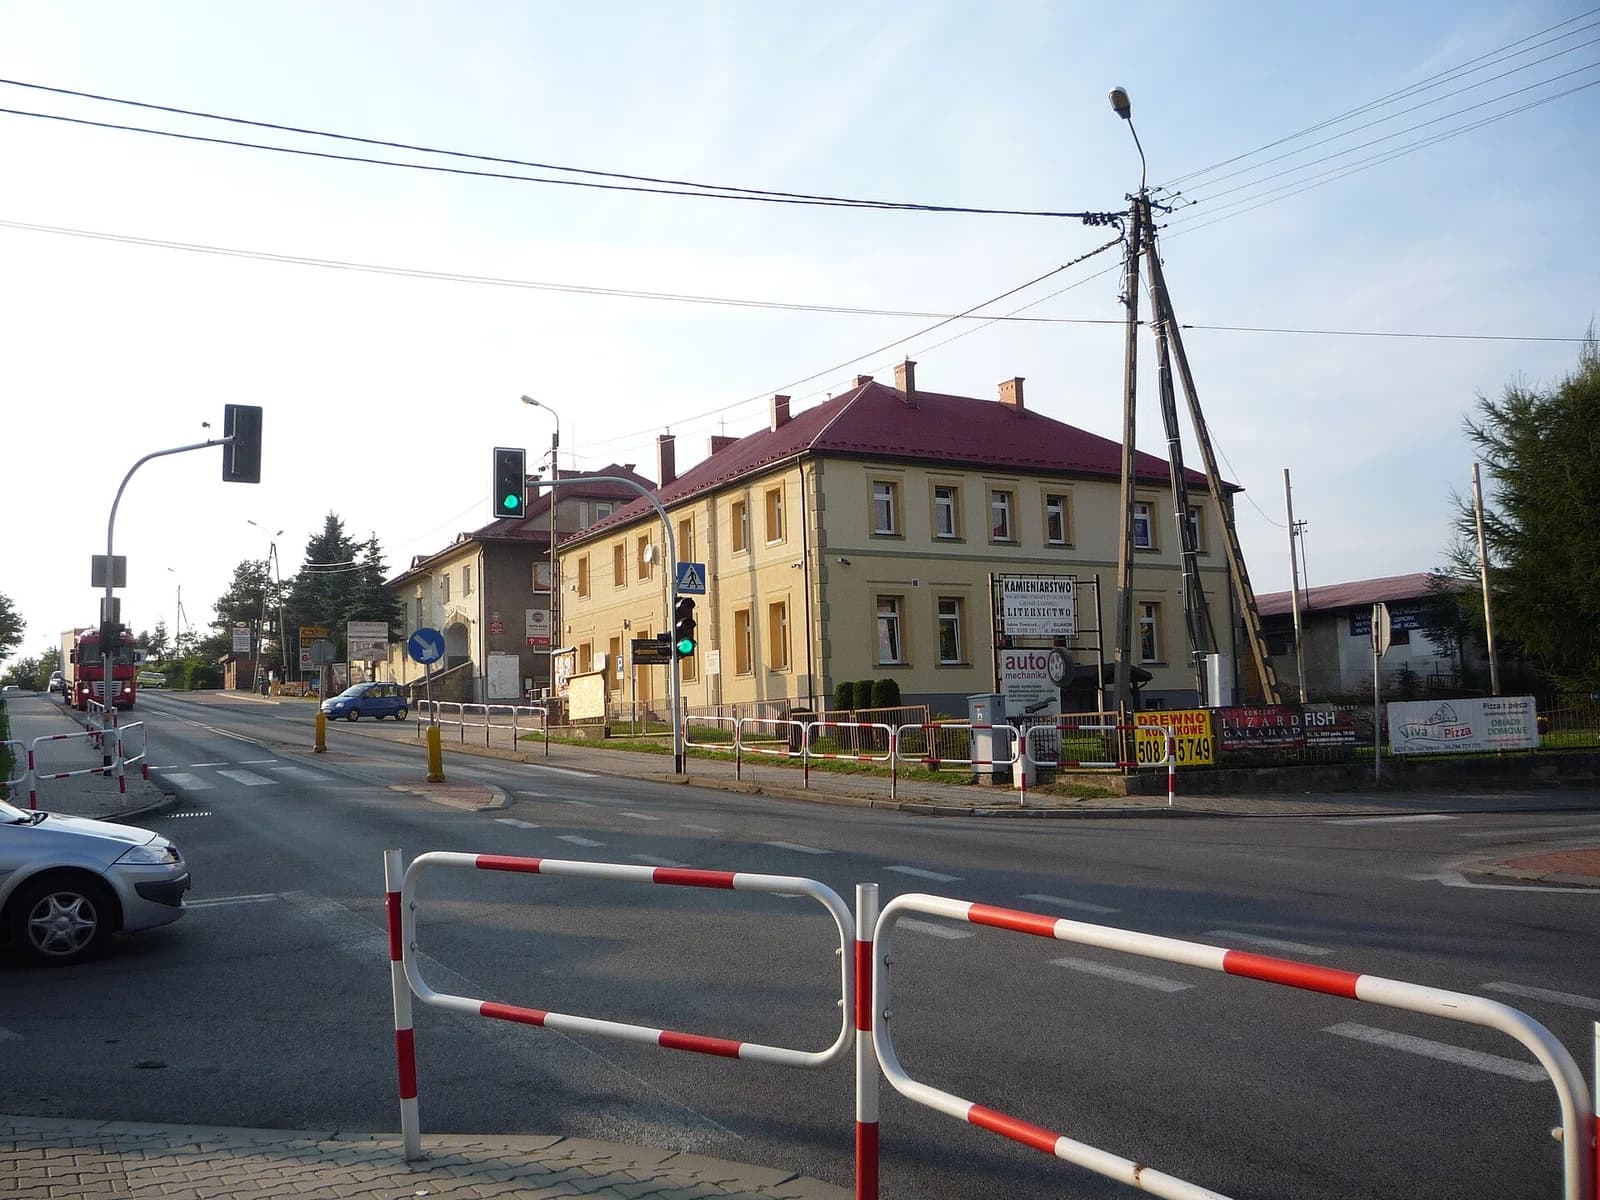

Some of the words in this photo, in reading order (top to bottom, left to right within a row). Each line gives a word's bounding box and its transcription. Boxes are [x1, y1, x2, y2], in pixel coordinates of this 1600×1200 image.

[1005, 581, 1072, 593] KAMIENIARSTWO
[1007, 607, 1071, 617] LITERNICTWO
[1005, 652, 1047, 670] auto
[1005, 671, 1047, 680] mechanika
[1137, 713, 1206, 726] DREWNO
[1222, 715, 1299, 729] LIZARD
[1304, 711, 1335, 726] FISH
[1491, 719, 1521, 727] OBIADY
[1223, 728, 1301, 738] GALAHAD
[1400, 727, 1428, 739] Viva
[1444, 727, 1472, 738] Pizza
[1487, 727, 1528, 736] DOMOWE
[1138, 740, 1161, 763] 508
[1187, 738, 1210, 761] 749
